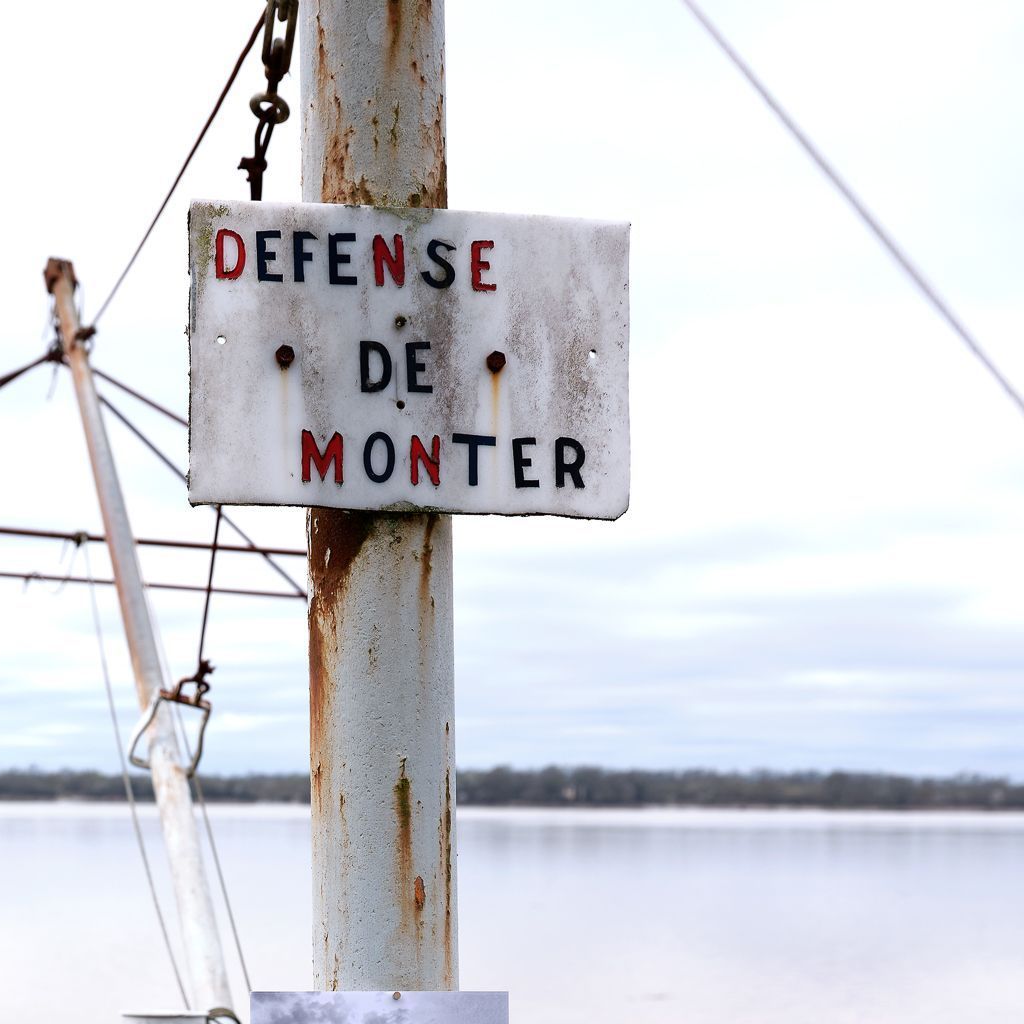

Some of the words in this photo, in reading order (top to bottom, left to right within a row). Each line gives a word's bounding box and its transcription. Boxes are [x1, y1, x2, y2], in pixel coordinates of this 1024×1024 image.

[214, 228, 498, 292] DEFENSE
[359, 340, 434, 394] DE
[301, 428, 587, 489] MONTER
